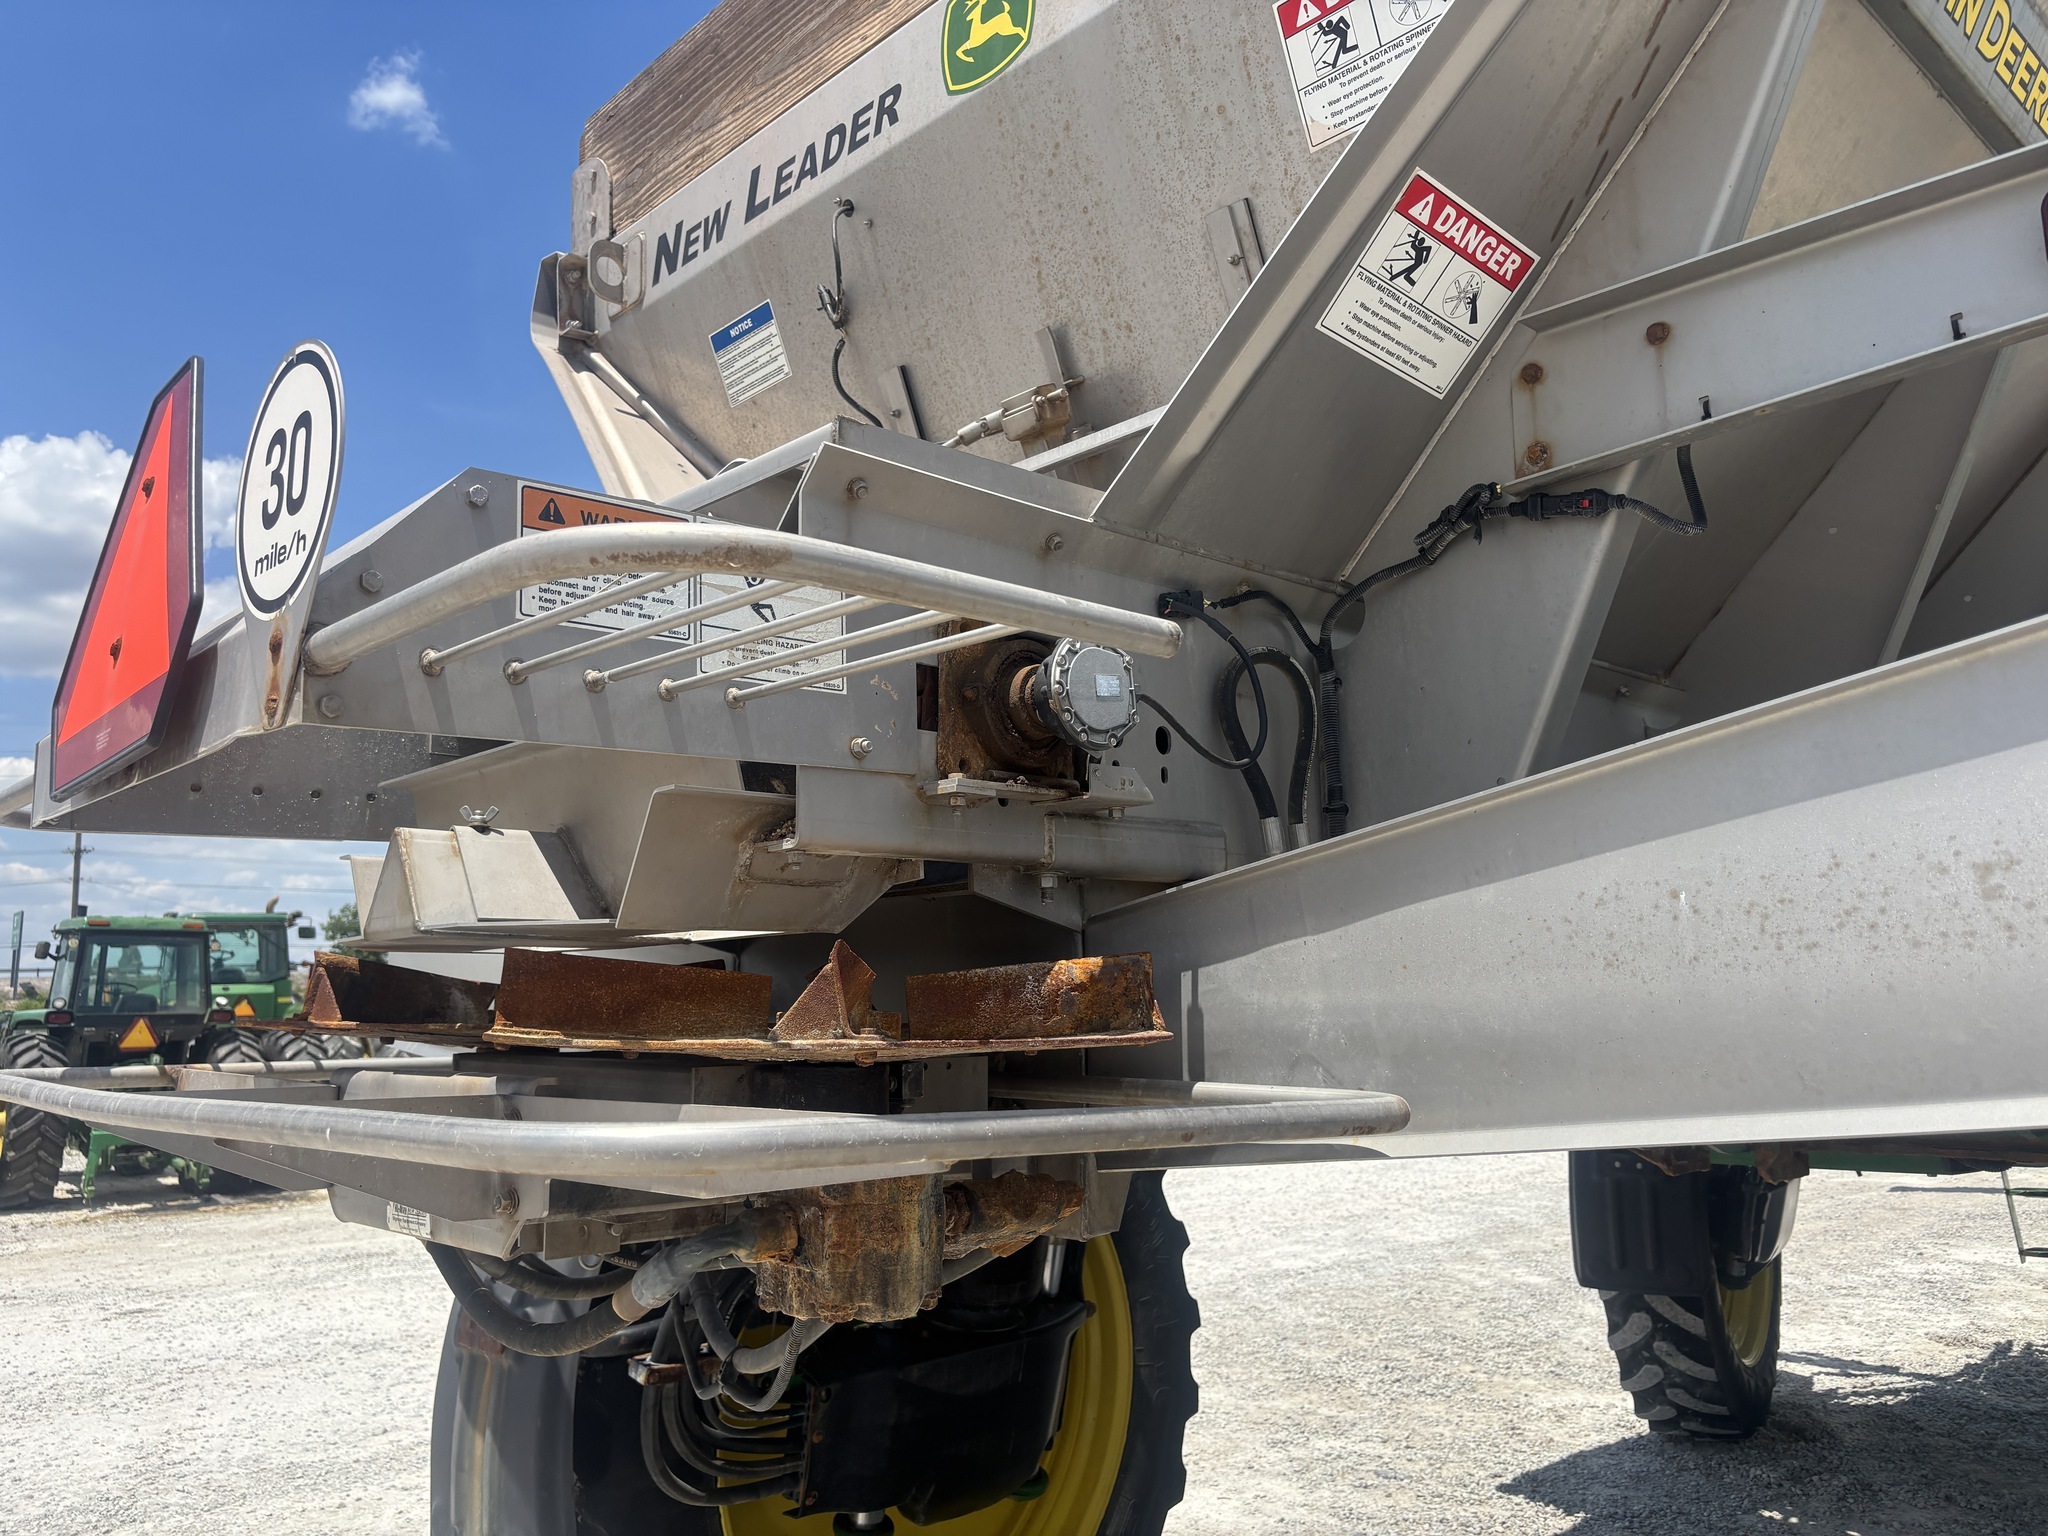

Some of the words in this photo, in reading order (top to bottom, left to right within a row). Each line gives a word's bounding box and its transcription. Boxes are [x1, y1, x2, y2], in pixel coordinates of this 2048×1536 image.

[1303, 80, 1328, 98] FLYING
[1327, 62, 1362, 84] MATERIAL
[1362, 58, 1369, 67] &
[1368, 39, 1405, 63] ROTATING
[1347, 70, 1369, 87] prevent
[1369, 61, 1386, 73] death
[1386, 56, 1393, 64] or
[1394, 45, 1417, 60] serious
[1975, 0, 2048, 139] DEER
[1327, 96, 1342, 107] Wear
[1342, 90, 1353, 100] eye
[1353, 75, 1385, 94] protection.
[1330, 107, 1344, 119] Stop
[1344, 95, 1369, 111] machine
[1369, 86, 1388, 99] before
[1333, 118, 1348, 130] Keep
[1432, 203, 1523, 282] DANGER
[729, 317, 754, 338] NOTICE
[1356, 271, 1378, 288] FLYING
[1376, 283, 1403, 305] MATERIAL
[1406, 302, 1433, 323] ROTATING
[1431, 318, 1454, 336] SPINNER
[1451, 331, 1473, 347] HAZARD
[1359, 301, 1372, 313] Wear
[1370, 309, 1380, 318] eye
[1377, 297, 1385, 305] To
[1382, 302, 1402, 316] prevent
[1400, 311, 1412, 322] death
[1416, 322, 1433, 335] serious
[1344, 323, 1357, 336] Keep
[1356, 330, 1381, 349] bystanders
[1385, 347, 1397, 359] least
[1351, 312, 1364, 324] Stop
[1362, 320, 1381, 335] machine
[1380, 330, 1396, 343] before
[1394, 339, 1415, 355] servicing
[261, 409, 313, 532] 30
[253, 528, 307, 578] mile/h
[538, 585, 562, 597] before
[538, 595, 558, 607] Keep
[604, 606, 618, 615] and
[621, 608, 635, 618] hair
[637, 612, 656, 621] away
[582, 584, 596, 593] and
[651, 596, 675, 606] source
